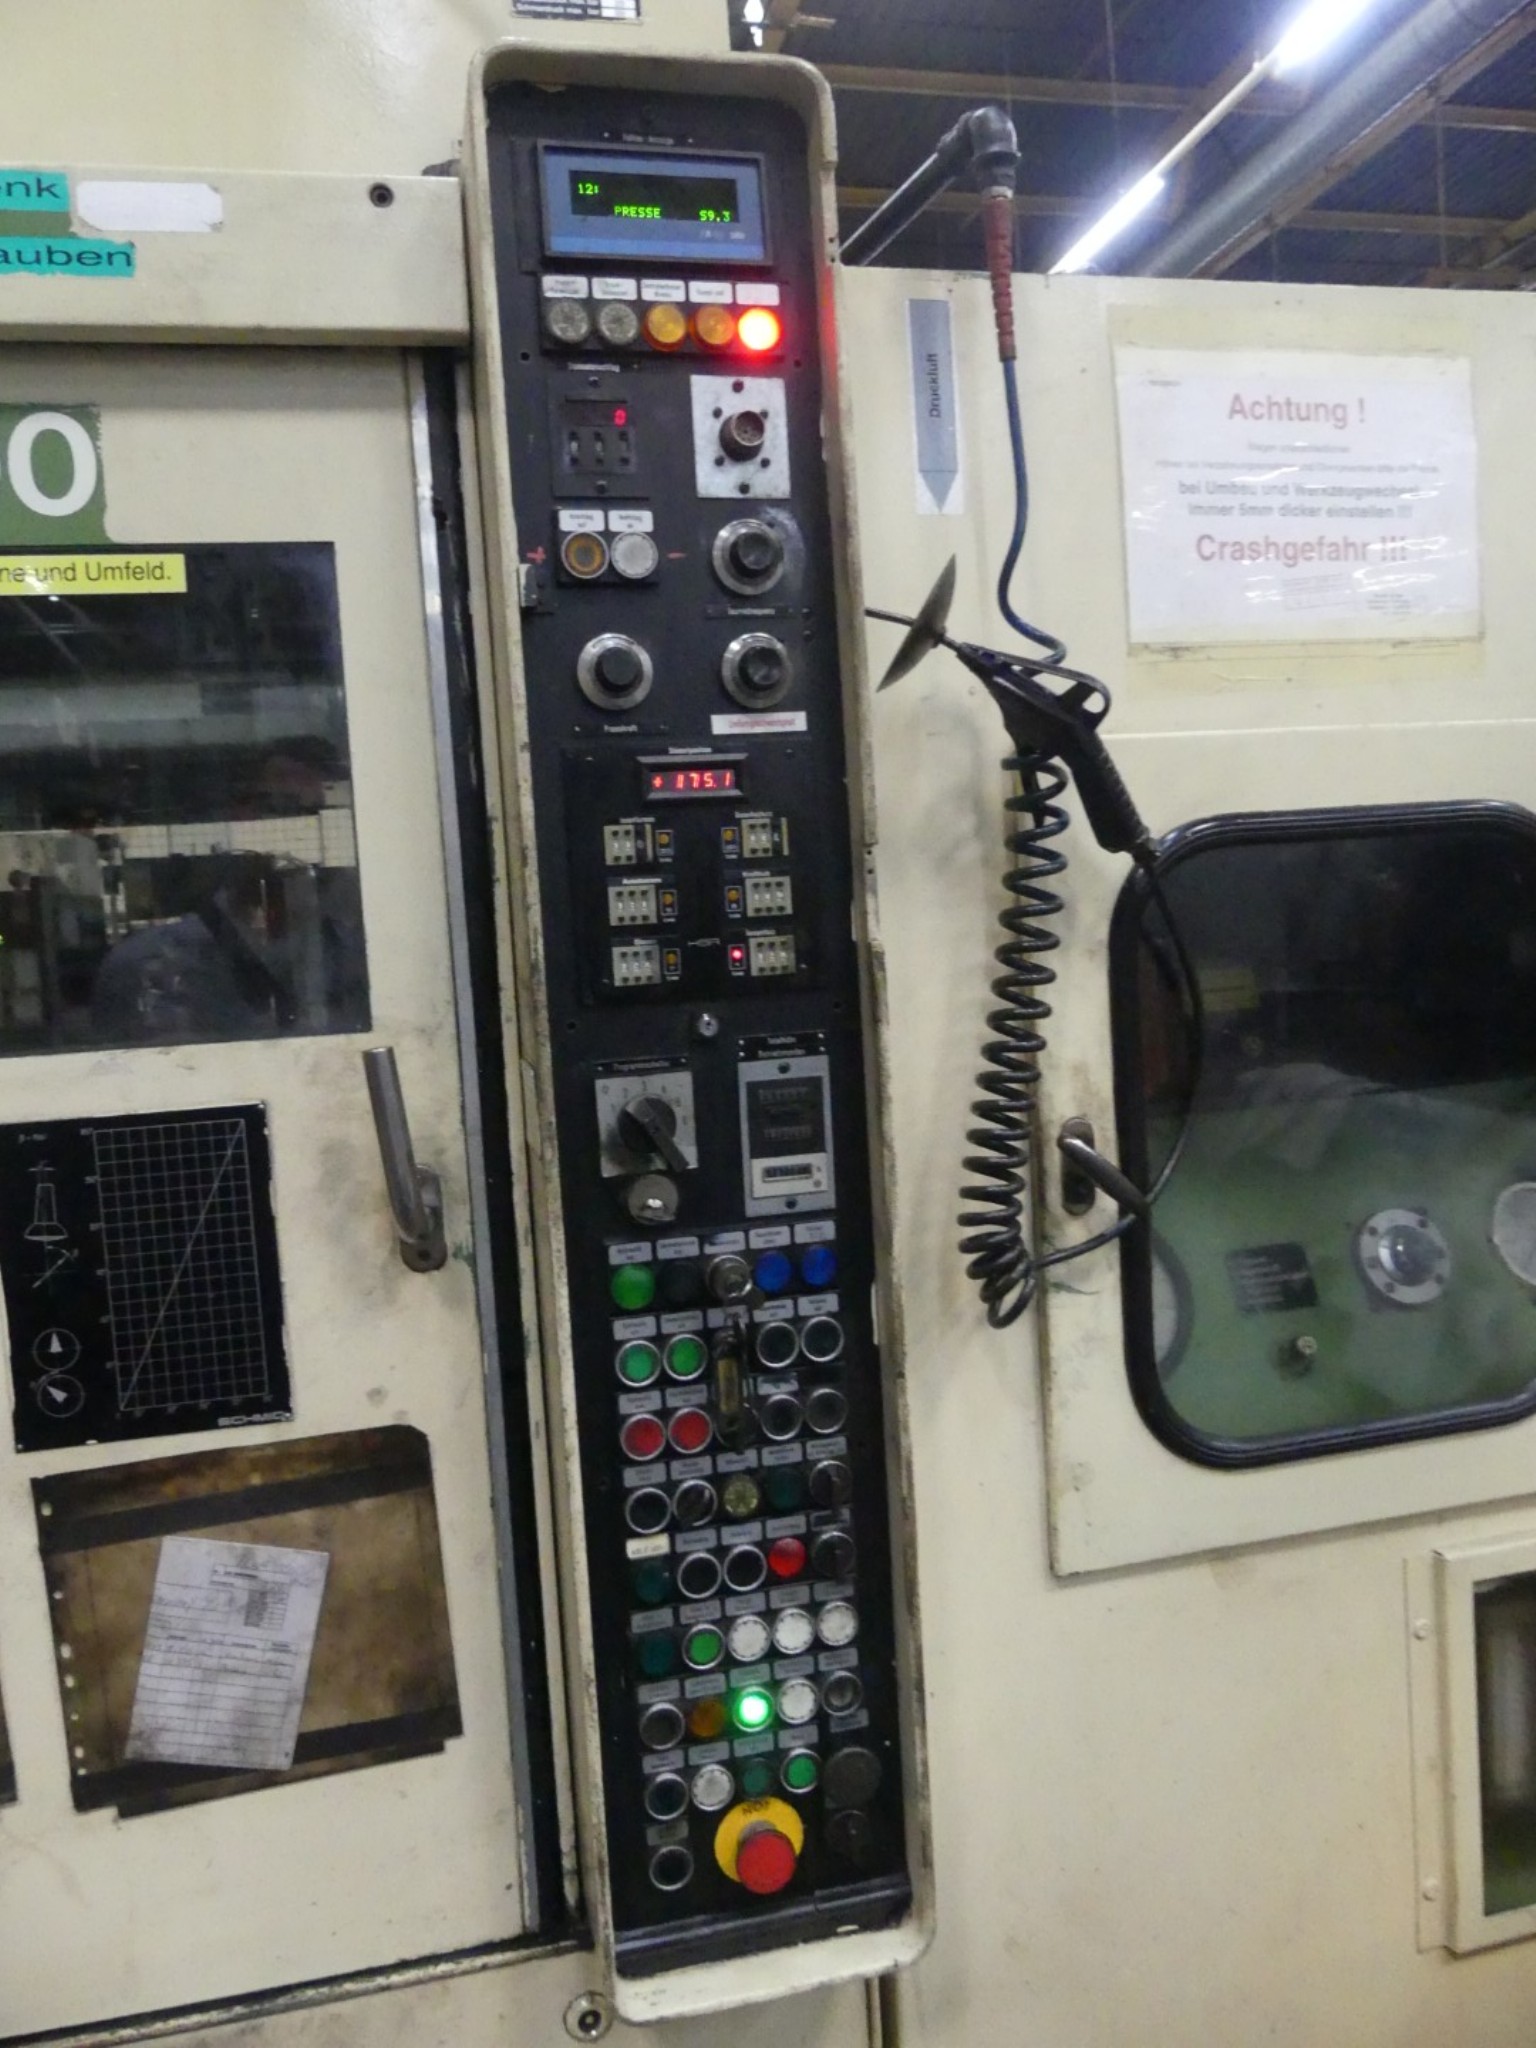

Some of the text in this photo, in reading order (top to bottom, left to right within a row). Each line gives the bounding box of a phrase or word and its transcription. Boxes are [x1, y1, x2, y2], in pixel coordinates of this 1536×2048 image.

[0, 177, 60, 199] nk
[613, 205, 662, 219] PRESSE
[925, 353, 941, 418] Druckluft
[1228, 393, 1366, 430] Achtung !
[1195, 533, 1370, 568] Crashgefahr
[35, 562, 77, 582] und
[85, 561, 172, 581] Umfeld.
